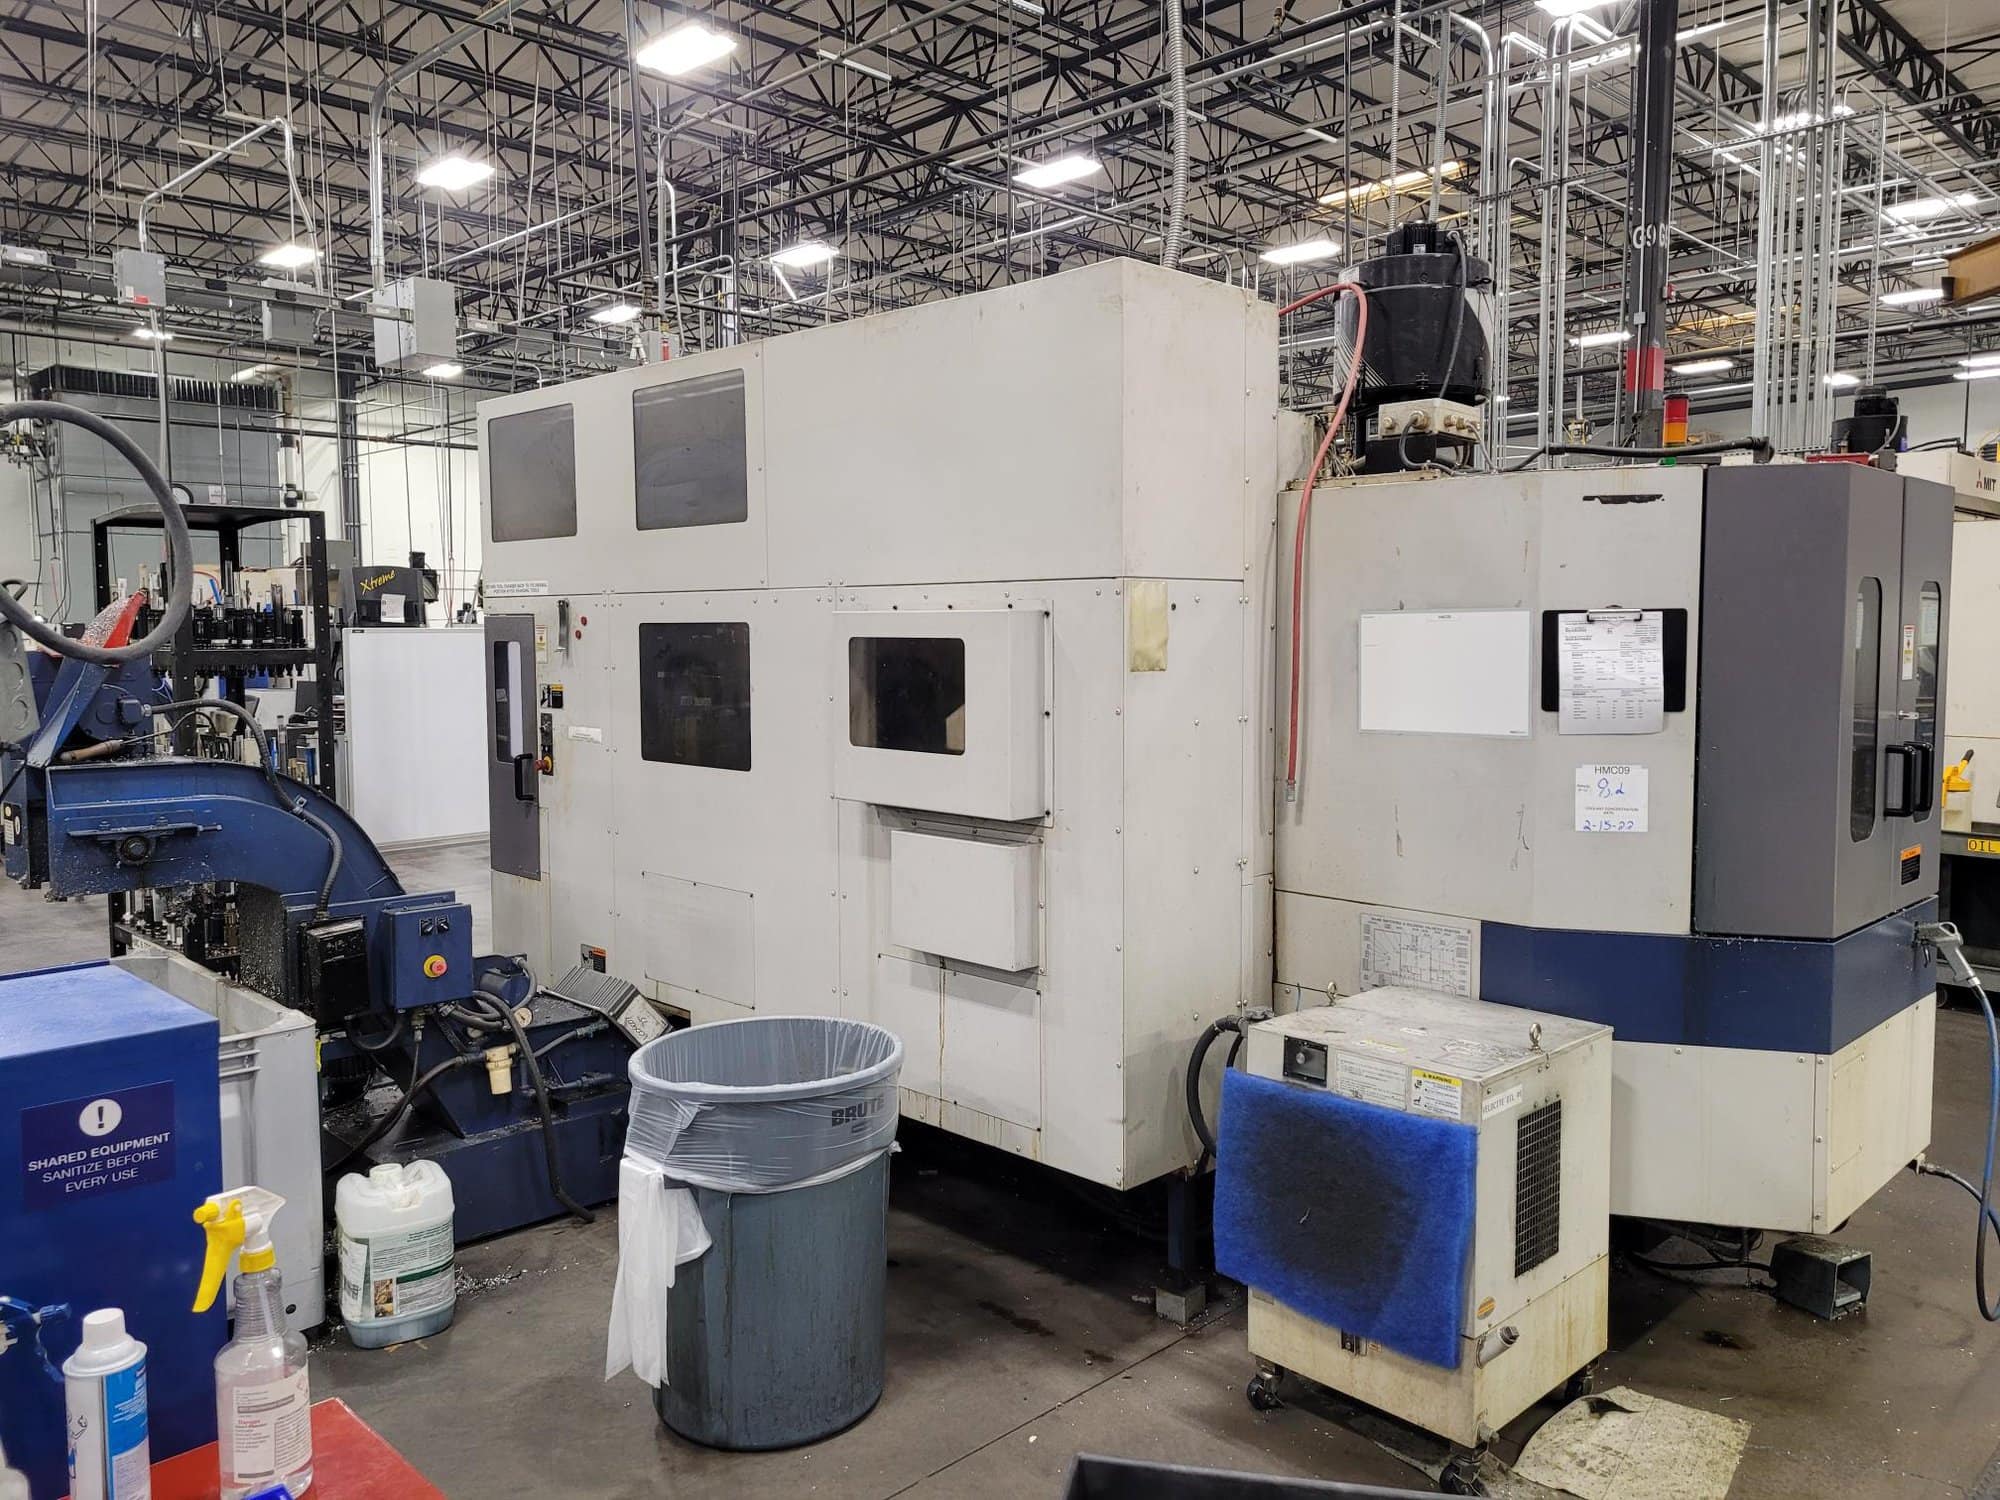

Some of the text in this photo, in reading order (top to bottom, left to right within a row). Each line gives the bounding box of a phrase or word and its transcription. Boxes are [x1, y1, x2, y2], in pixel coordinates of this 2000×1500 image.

[1633, 223, 1656, 249] G9
[360, 569, 396, 596] Xtreme
[1594, 766, 1631, 775] HMC09
[1583, 819, 1635, 832] 2-15-22
[1969, 840, 1994, 852] OIL
[832, 1094, 885, 1127] BRUTE
[28, 1132, 171, 1172] SHARED EQUIPMENT
[42, 1149, 159, 1184] SANITIZE BEFORE
[65, 1167, 139, 1193] EVERY USE
